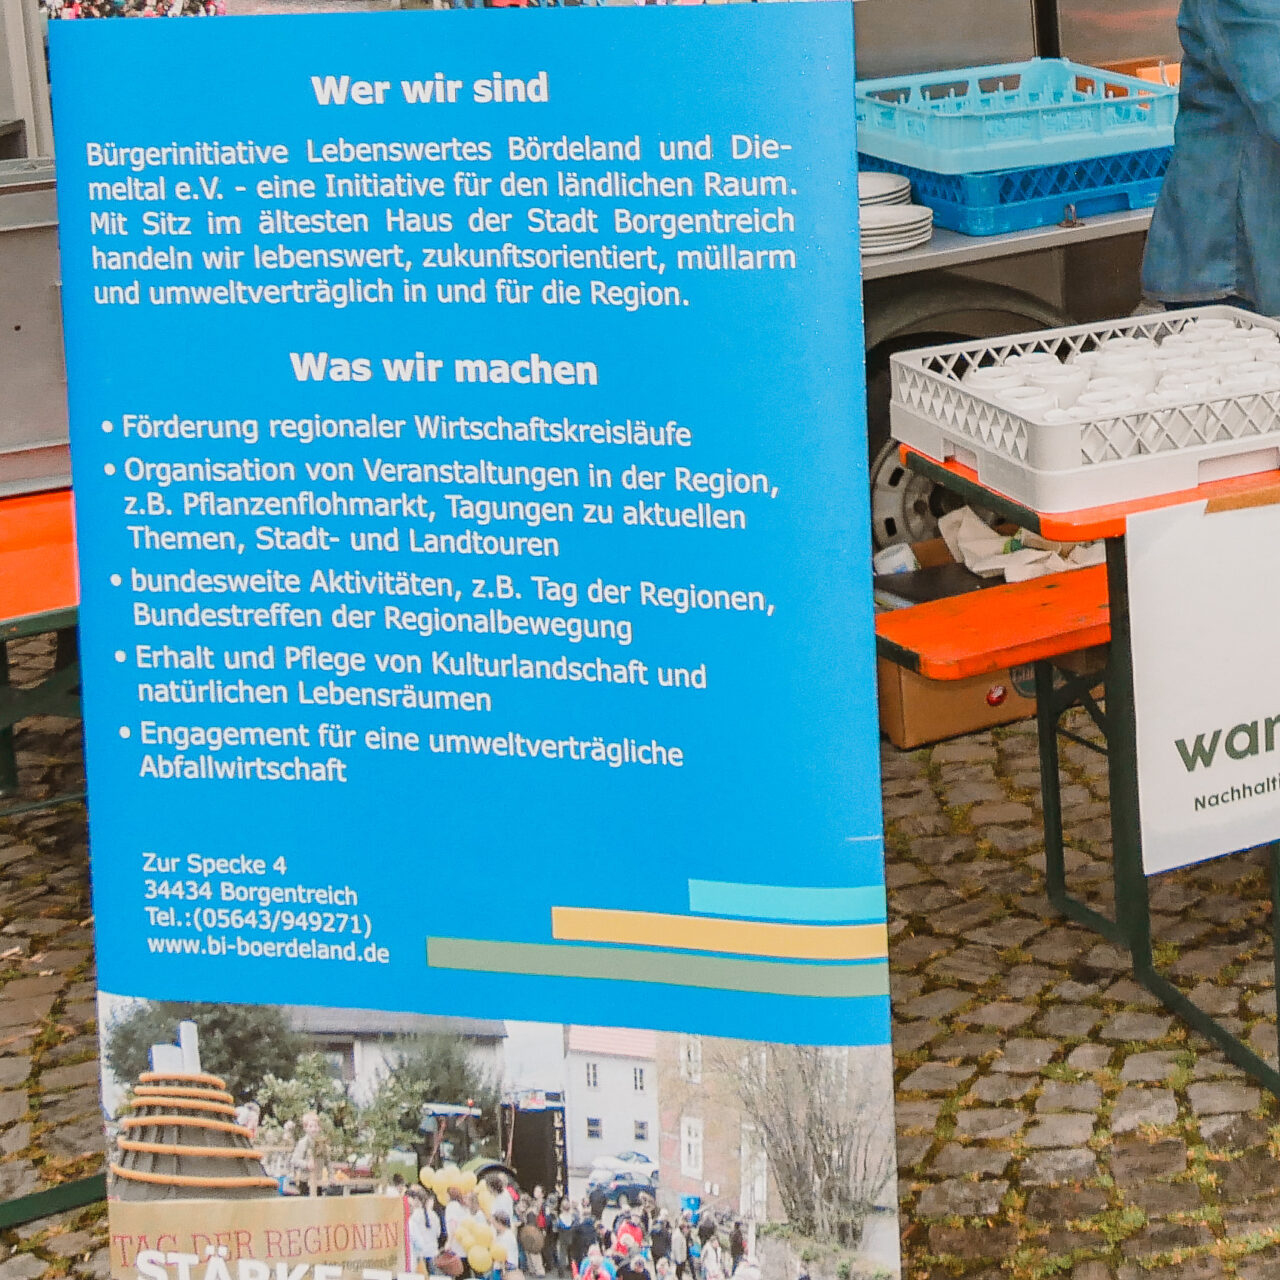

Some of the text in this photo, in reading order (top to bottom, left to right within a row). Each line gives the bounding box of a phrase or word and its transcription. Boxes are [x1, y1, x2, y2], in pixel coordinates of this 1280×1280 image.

[310, 70, 549, 106] Wer wir sind
[86, 133, 793, 172] Bürgerinitiative Lebenswertes Bördeland und Die-
[91, 242, 797, 275] handeln wir lebenswert, zukunftsorientiert, müllarm
[289, 351, 598, 386] Was wir machen
[122, 413, 692, 447] Förderung regionaler Wirtschaftskreisläufe
[124, 456, 779, 499] Organisation von Veranstaltungen in der Region,
[126, 525, 559, 557] Themen, Stadt- und Landtouren
[131, 567, 775, 617] bundesweite Aktivitäten, z.B. Tag der Regionen,
[133, 602, 633, 646] Bundestreffen der Regionalbewegung
[135, 644, 707, 689] Erhalt und Pflege von Kulturlandschaft und
[138, 679, 492, 712] natürlichen Lebensräumen
[140, 720, 684, 768] Engagement für eine umweltverträgliche
[139, 754, 348, 783] Abfallwirtschaft
[142, 852, 288, 878] Zur Specke 4
[144, 879, 358, 907] 34434 Borgentreich
[143, 906, 372, 939] Tel.:(05643/949271)
[147, 935, 390, 964] www.bi-boerdeland.de
[267, 1220, 400, 1258] REGIONEN
